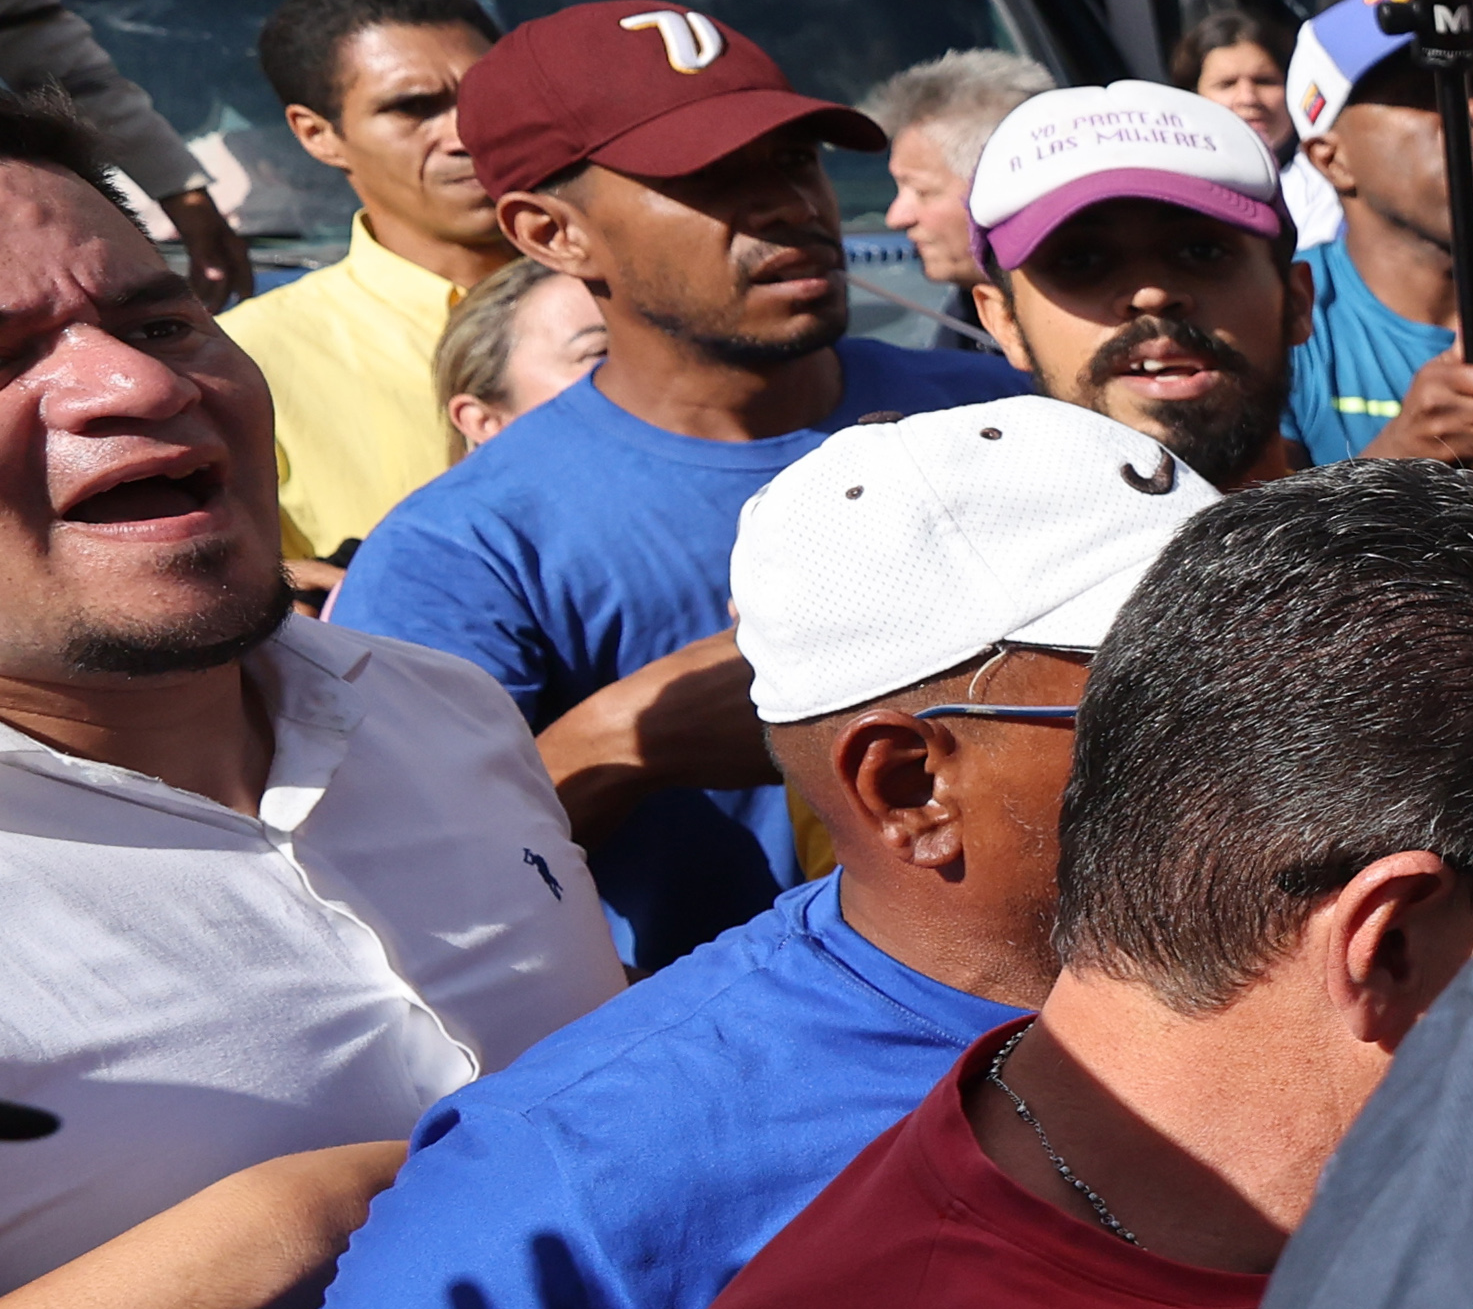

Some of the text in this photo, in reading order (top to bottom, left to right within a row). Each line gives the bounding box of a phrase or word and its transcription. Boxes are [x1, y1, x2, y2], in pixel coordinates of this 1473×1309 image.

[1433, 3, 1471, 35] M
[1030, 110, 1185, 141] YO PROTEJO
[1009, 128, 1218, 173] A LAS MUJERES
